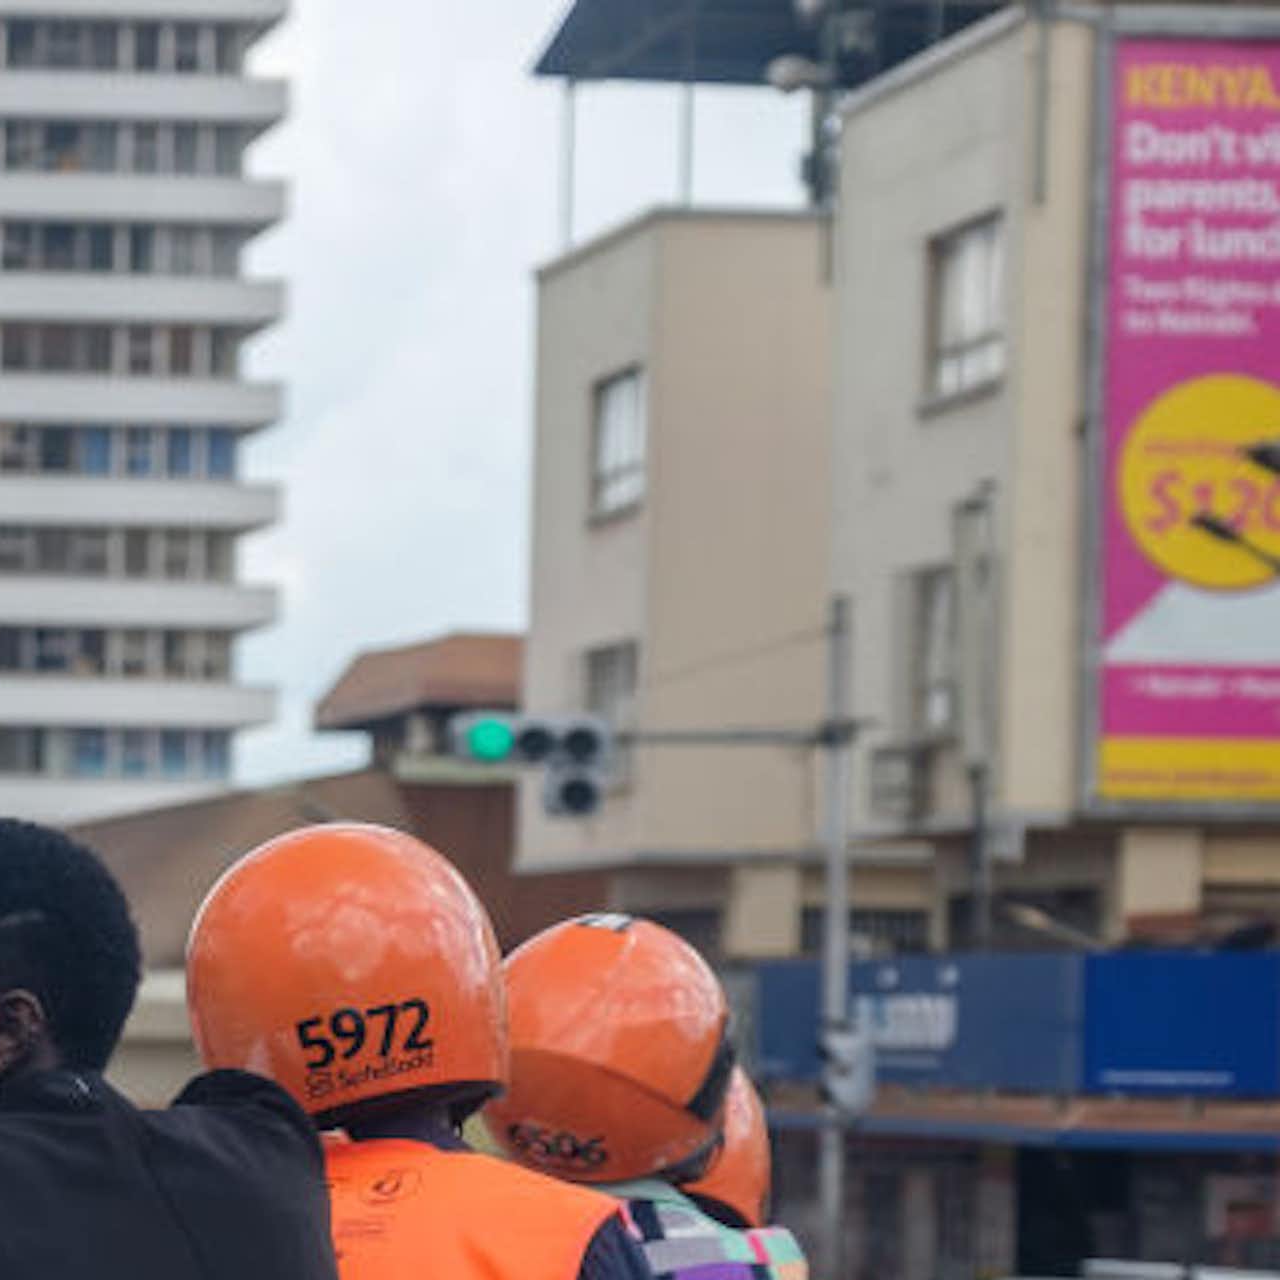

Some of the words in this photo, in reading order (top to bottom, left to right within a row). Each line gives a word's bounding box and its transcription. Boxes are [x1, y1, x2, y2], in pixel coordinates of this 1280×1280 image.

[1124, 121, 1234, 165] Don't
[1123, 222, 1181, 258] for
[295, 998, 433, 1068] 5972
